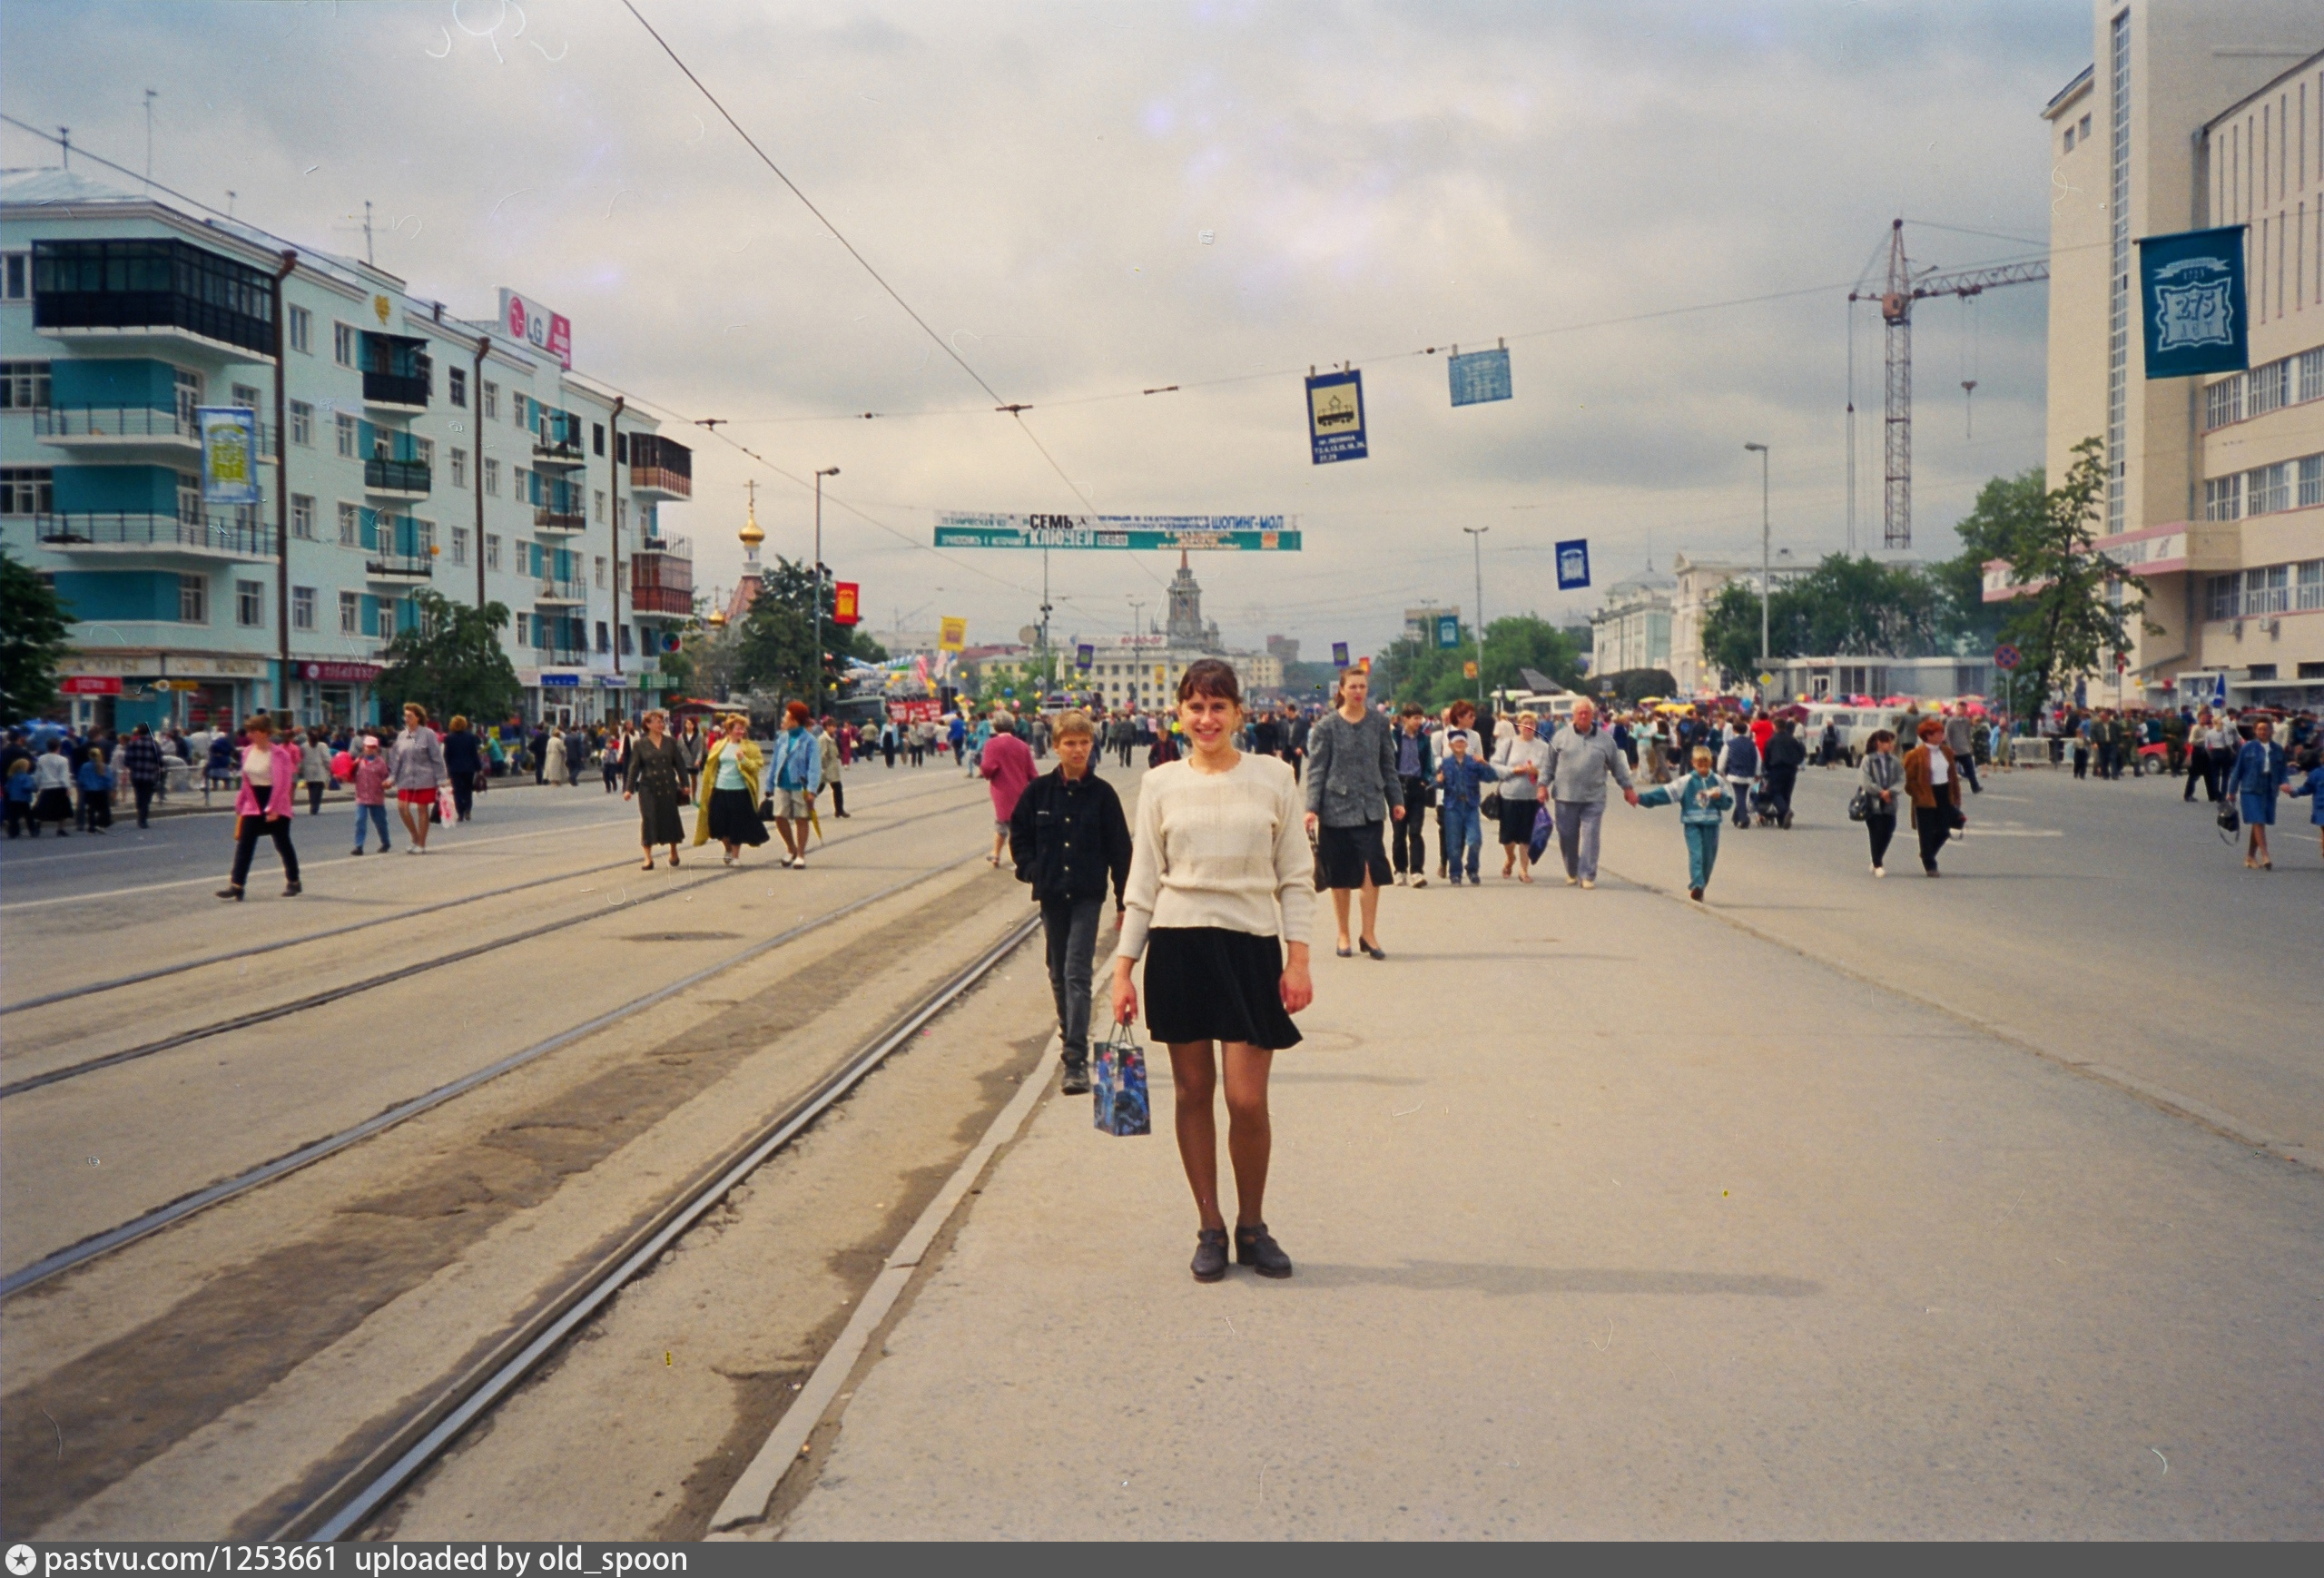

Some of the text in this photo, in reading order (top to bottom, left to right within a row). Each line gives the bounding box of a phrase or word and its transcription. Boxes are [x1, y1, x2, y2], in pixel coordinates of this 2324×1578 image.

[2175, 291, 2216, 321] 275
[527, 311, 543, 344] LG
[1029, 514, 1074, 529] СЕМЬ
[1030, 529, 1094, 545] КЛЮЧЕЙ
